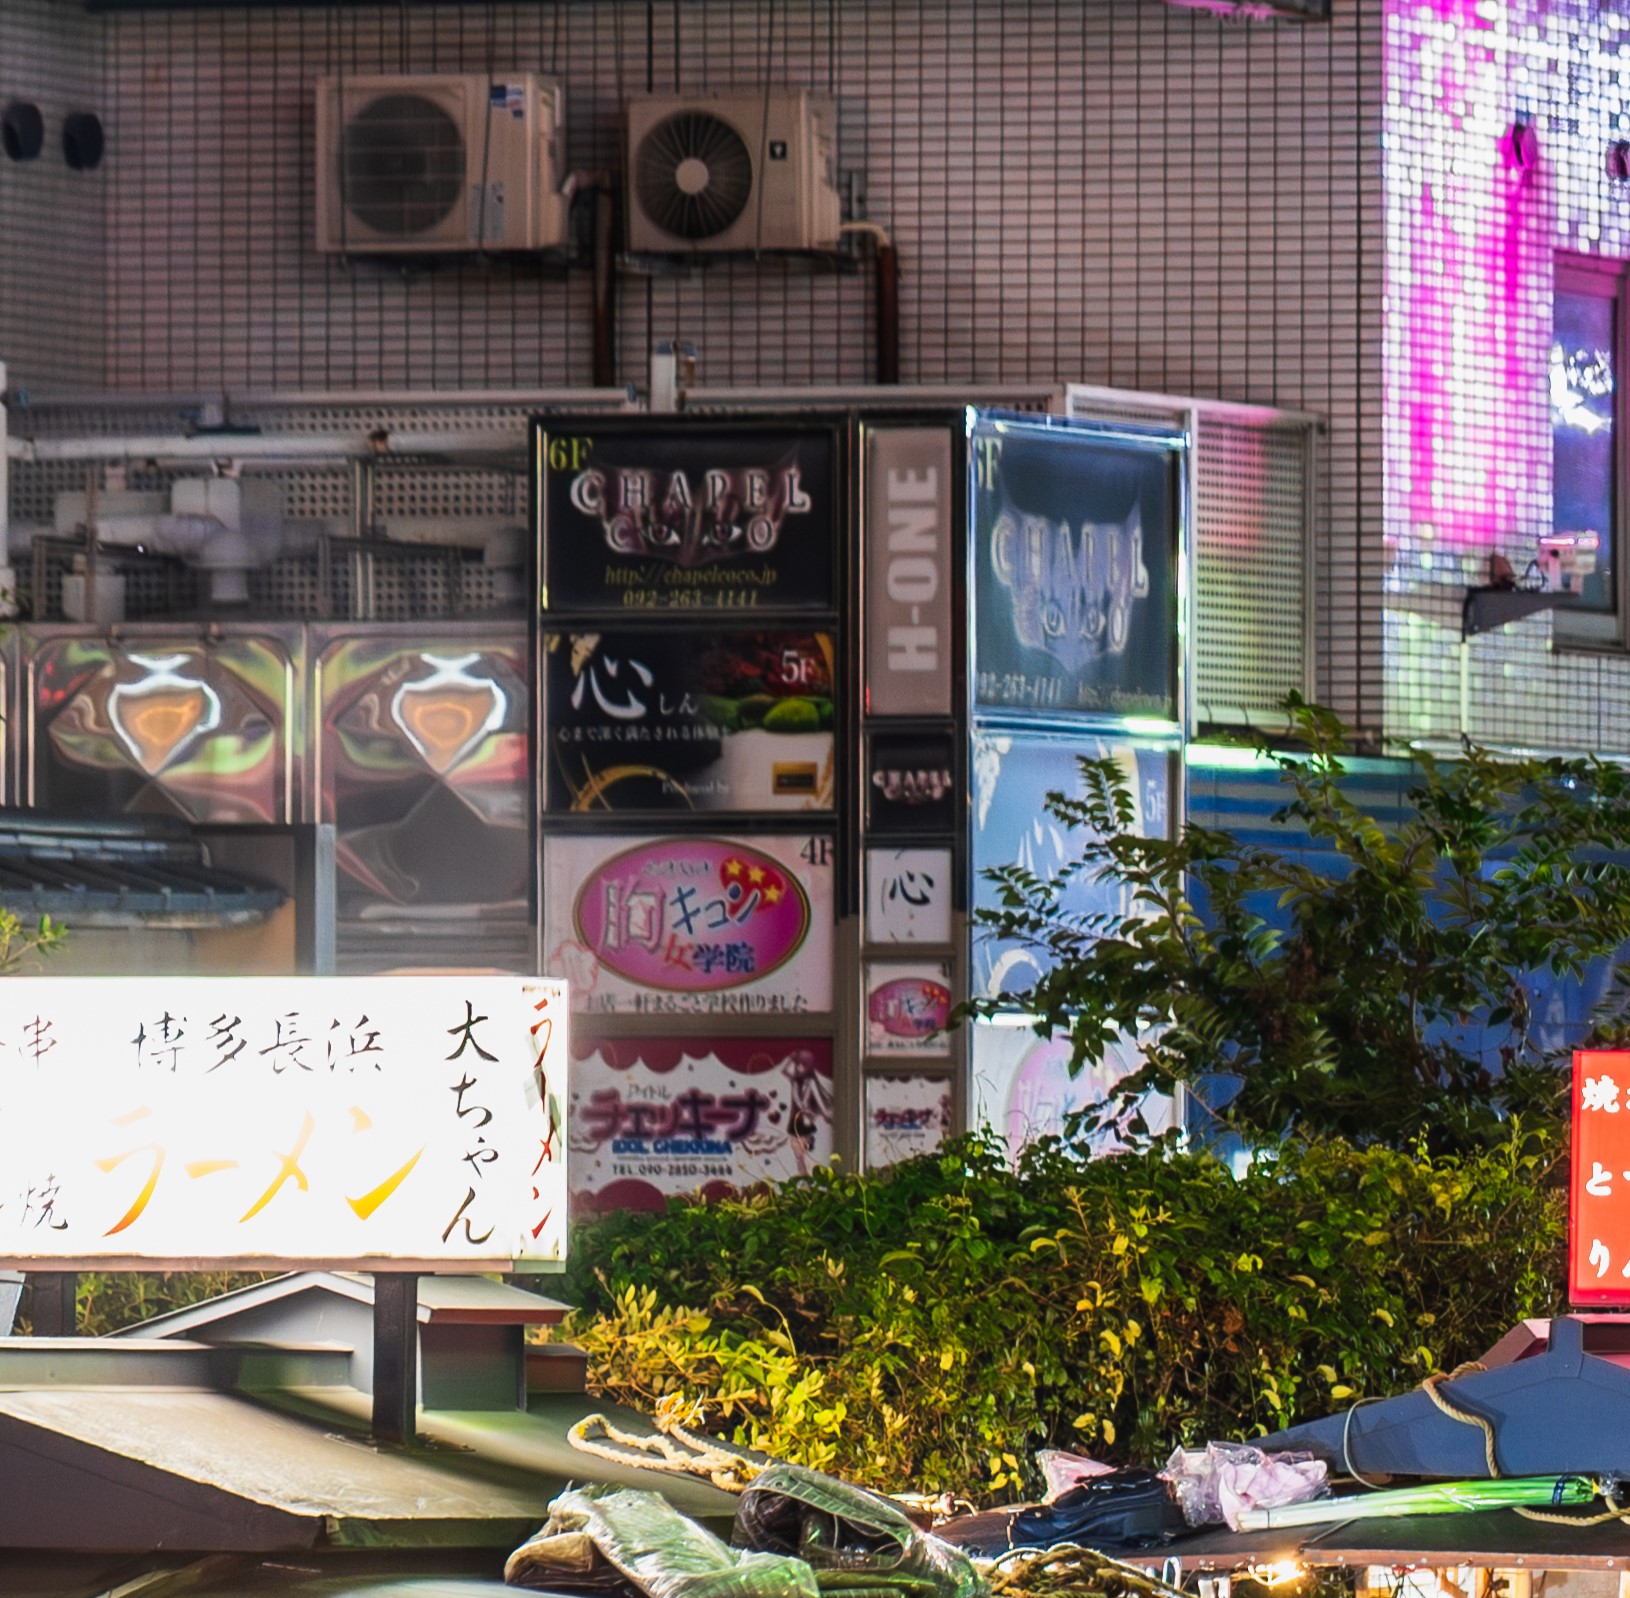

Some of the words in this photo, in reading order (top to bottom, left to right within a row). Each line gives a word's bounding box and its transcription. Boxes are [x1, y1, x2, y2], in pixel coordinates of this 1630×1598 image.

[550, 437, 592, 470] 6F
[570, 466, 811, 515] CHAPEL
[888, 465, 938, 671] H-ONE
[571, 655, 654, 719] 心
[781, 649, 816, 684] 5F
[889, 870, 935, 906] 心
[132, 1011, 384, 1074] 博多長浜
[442, 1000, 499, 1244] 大ちゃん
[531, 998, 554, 1240] ラーメン
[94, 1106, 426, 1238] ラーメン
[1581, 1075, 1620, 1278] 焼とり
